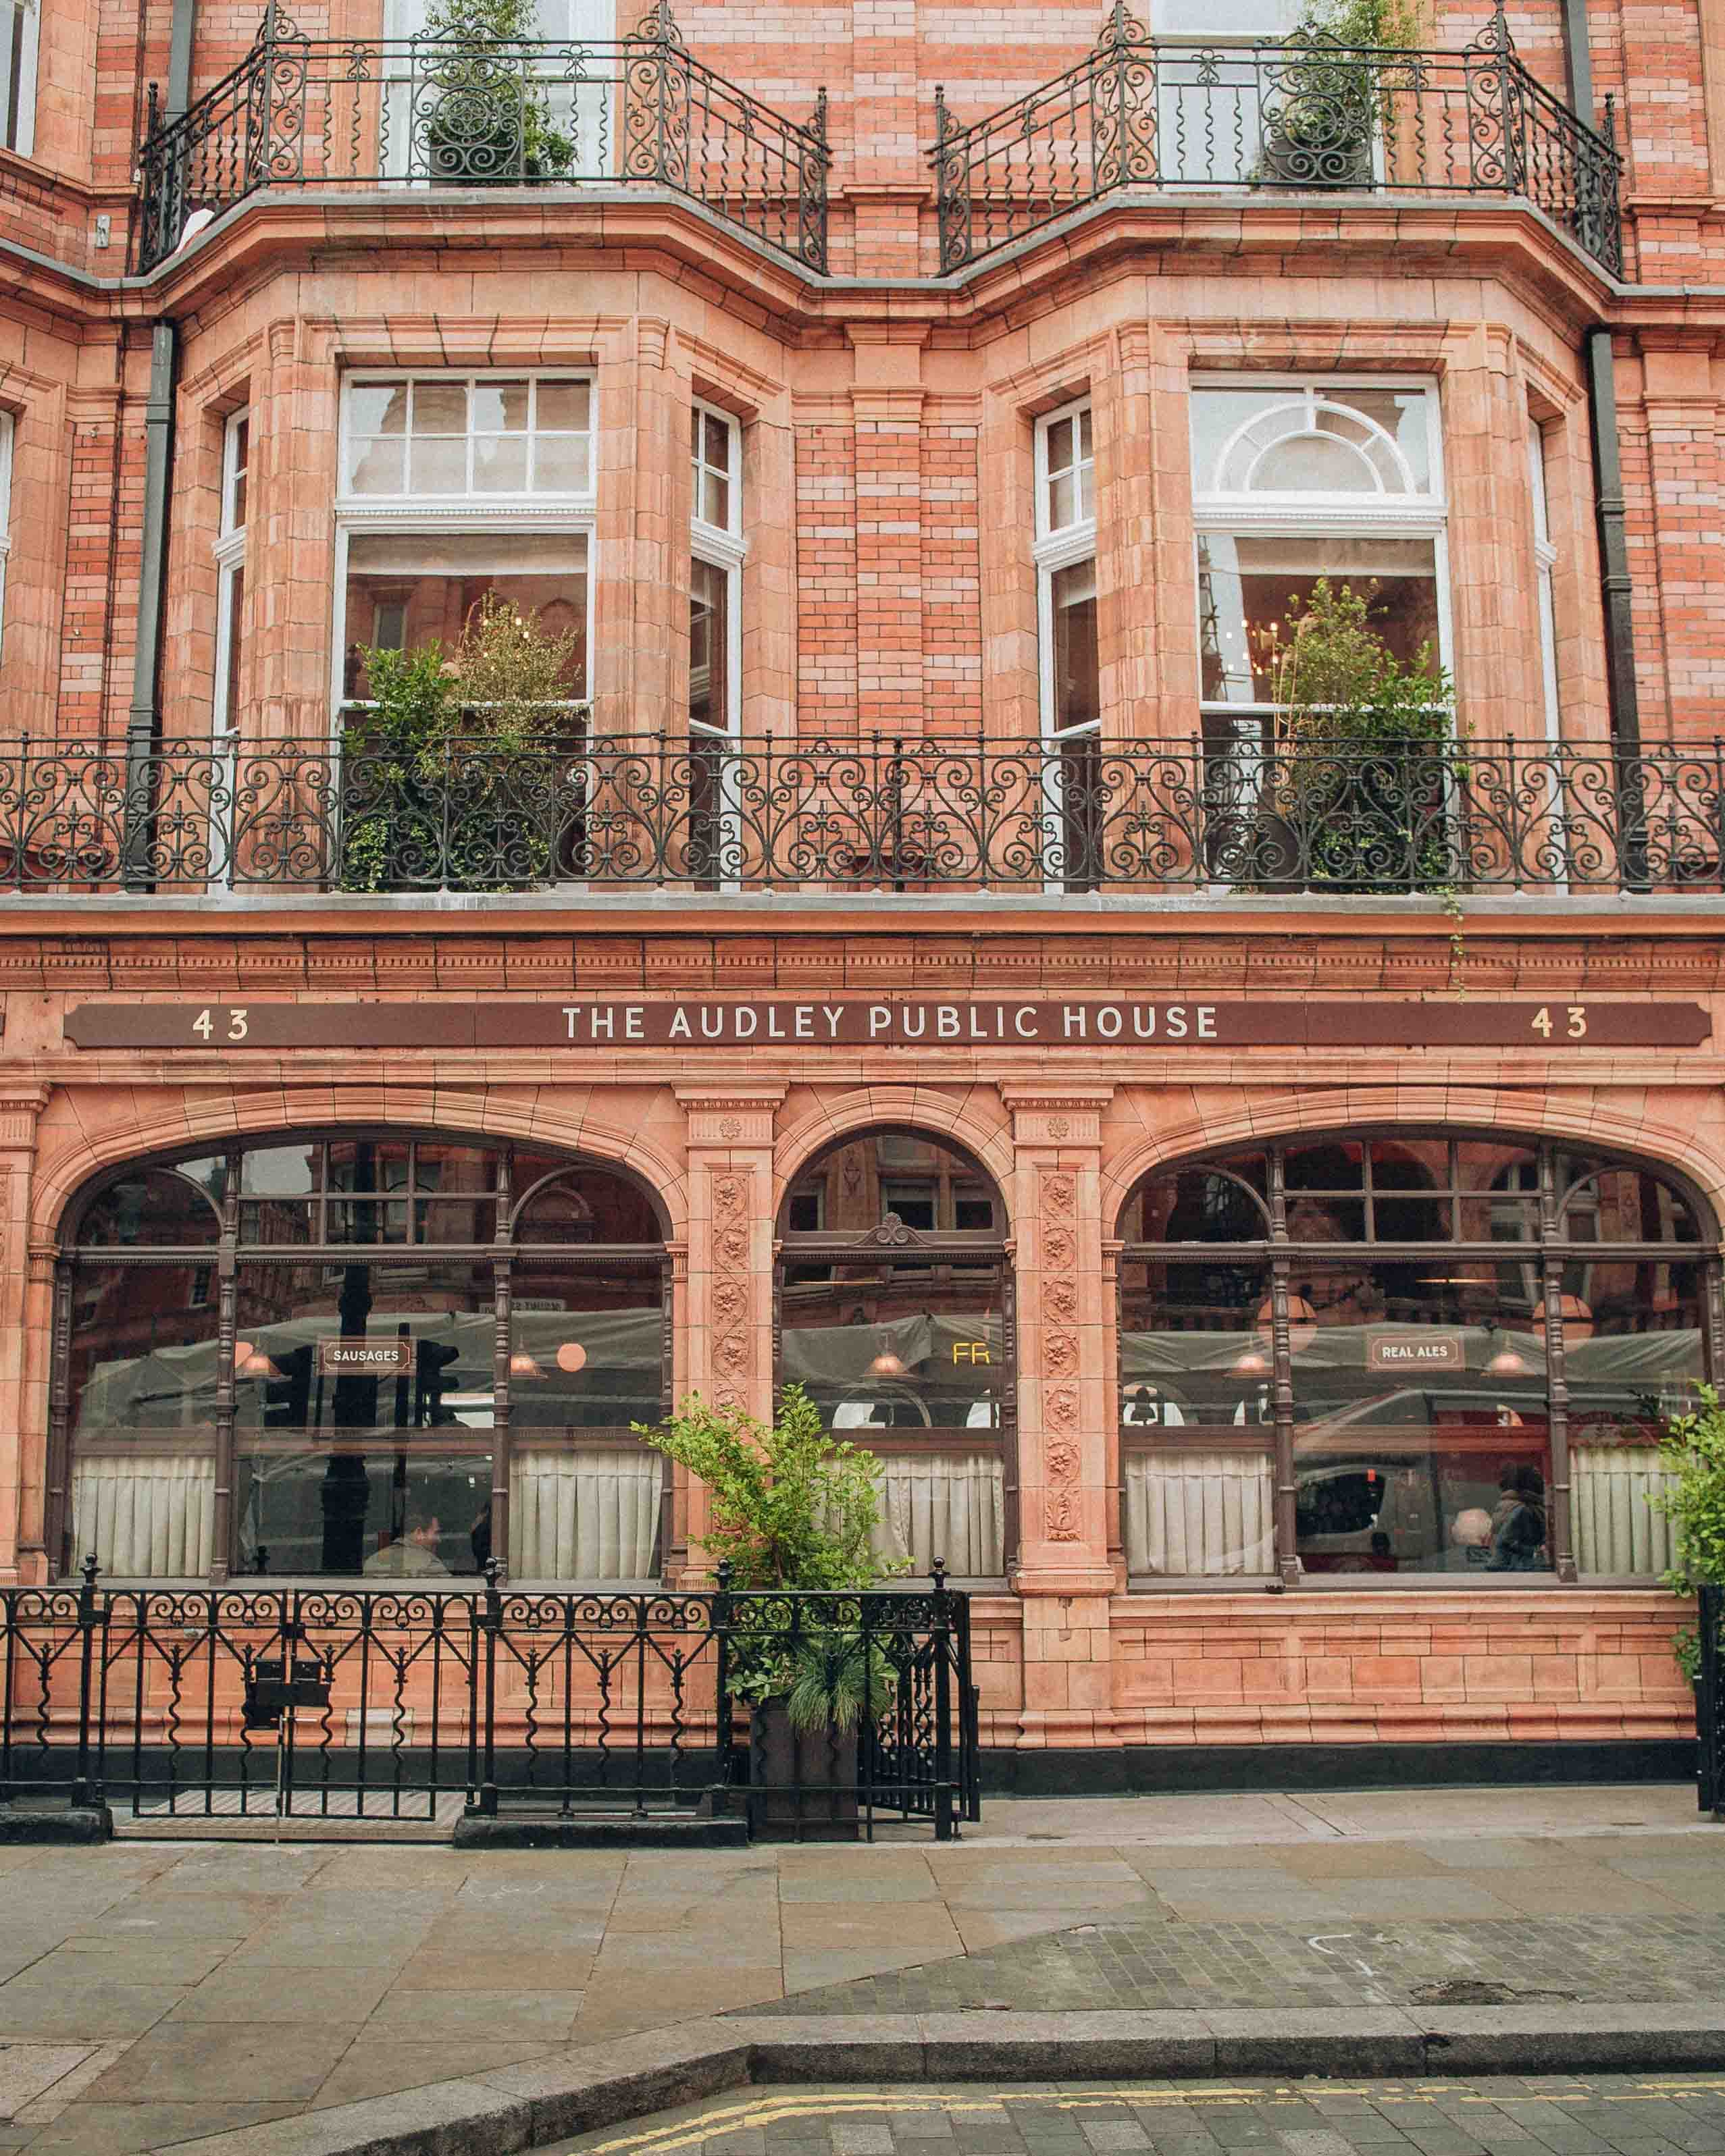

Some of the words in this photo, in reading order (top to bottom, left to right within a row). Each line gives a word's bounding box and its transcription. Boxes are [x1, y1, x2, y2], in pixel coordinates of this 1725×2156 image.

[192, 1009, 248, 1040] 43
[562, 1007, 644, 1038] THE
[668, 1006, 844, 1038] AUDLEY
[869, 1006, 1038, 1038] PUBLIC
[1063, 1006, 1218, 1038] HOUSE
[1531, 1007, 1587, 1038] 43
[333, 1350, 399, 1361] SAUSAGES
[1383, 1346, 1414, 1358] REAL
[1417, 1346, 1448, 1357] ALES
